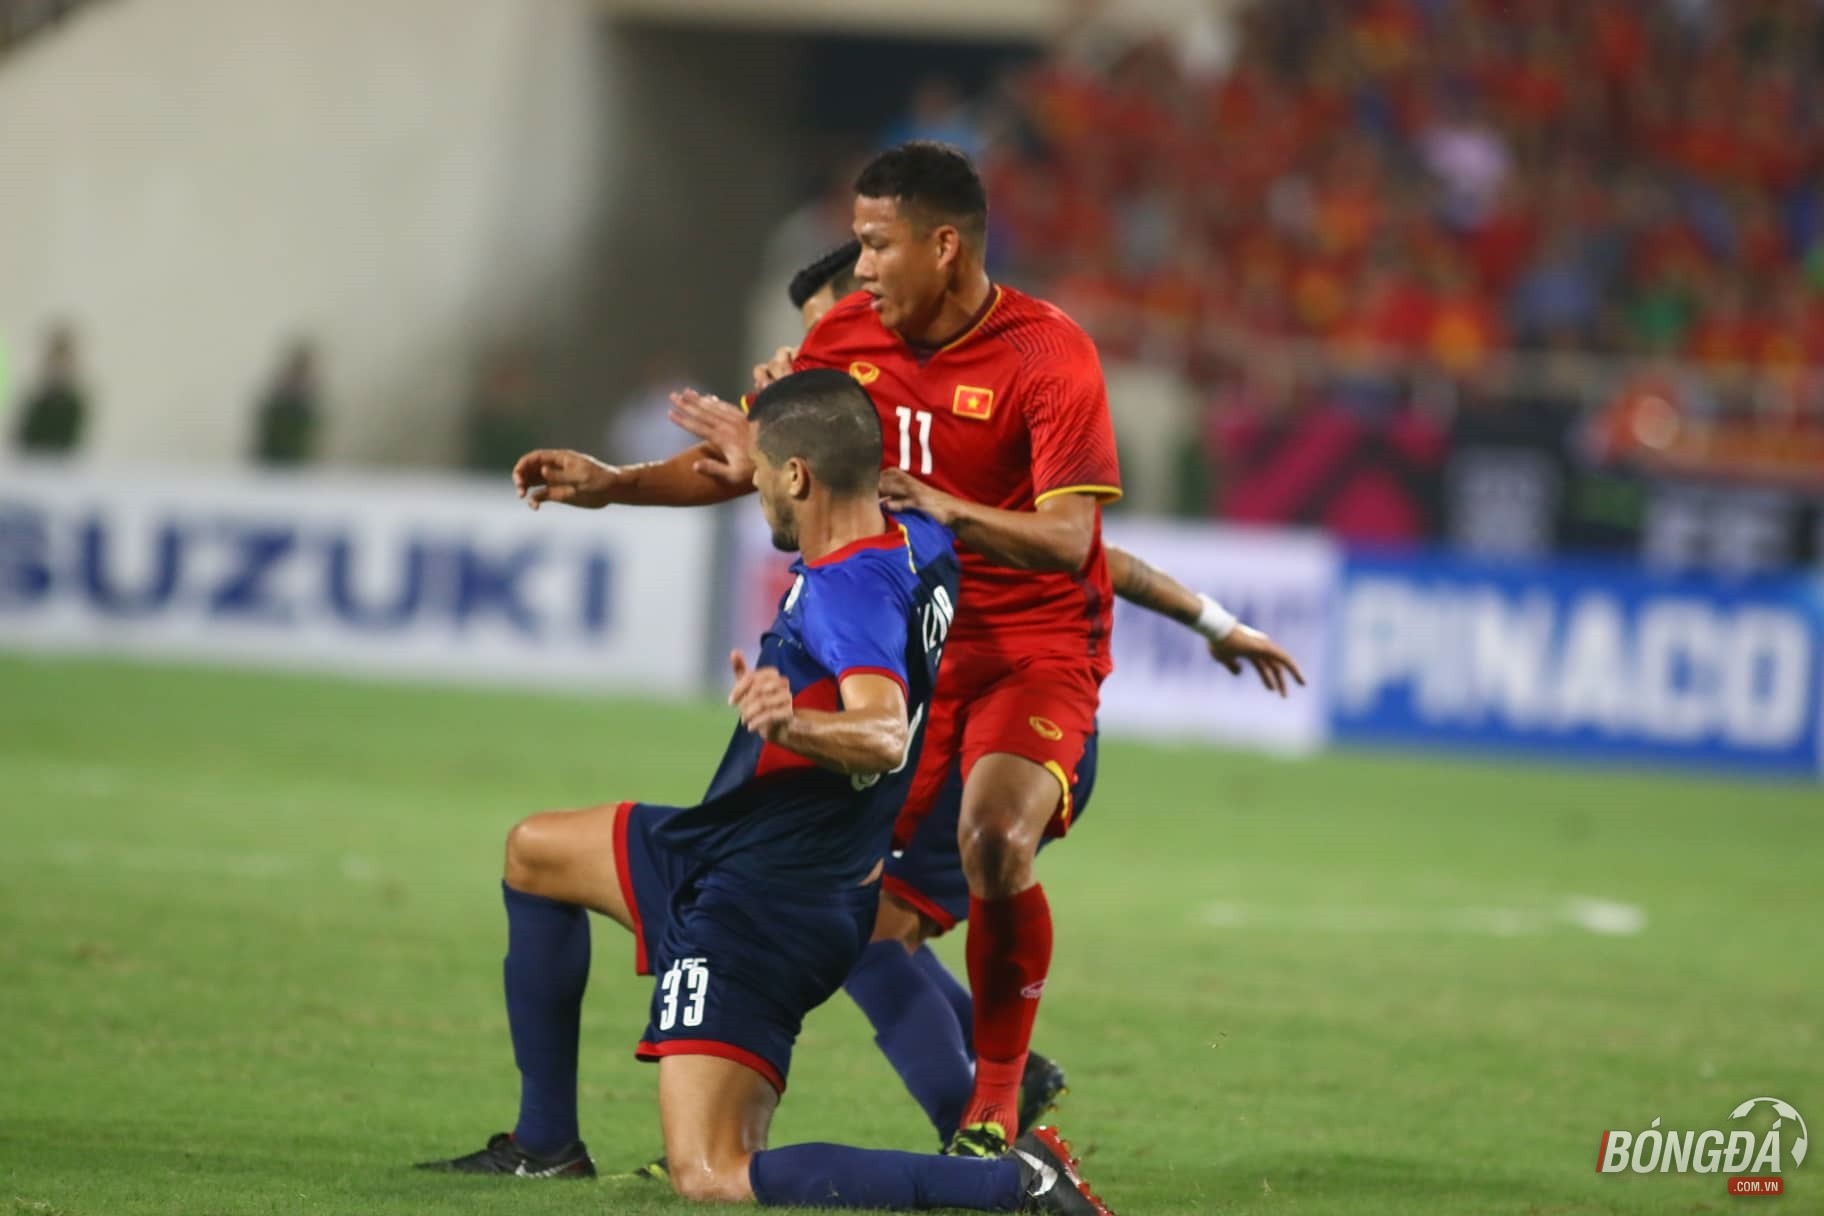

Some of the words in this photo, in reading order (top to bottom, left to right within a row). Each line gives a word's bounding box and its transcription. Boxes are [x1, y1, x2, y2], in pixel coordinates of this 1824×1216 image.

[895, 405, 933, 475] 11
[1337, 572, 1812, 748] PINACO
[659, 966, 709, 1031] 33
